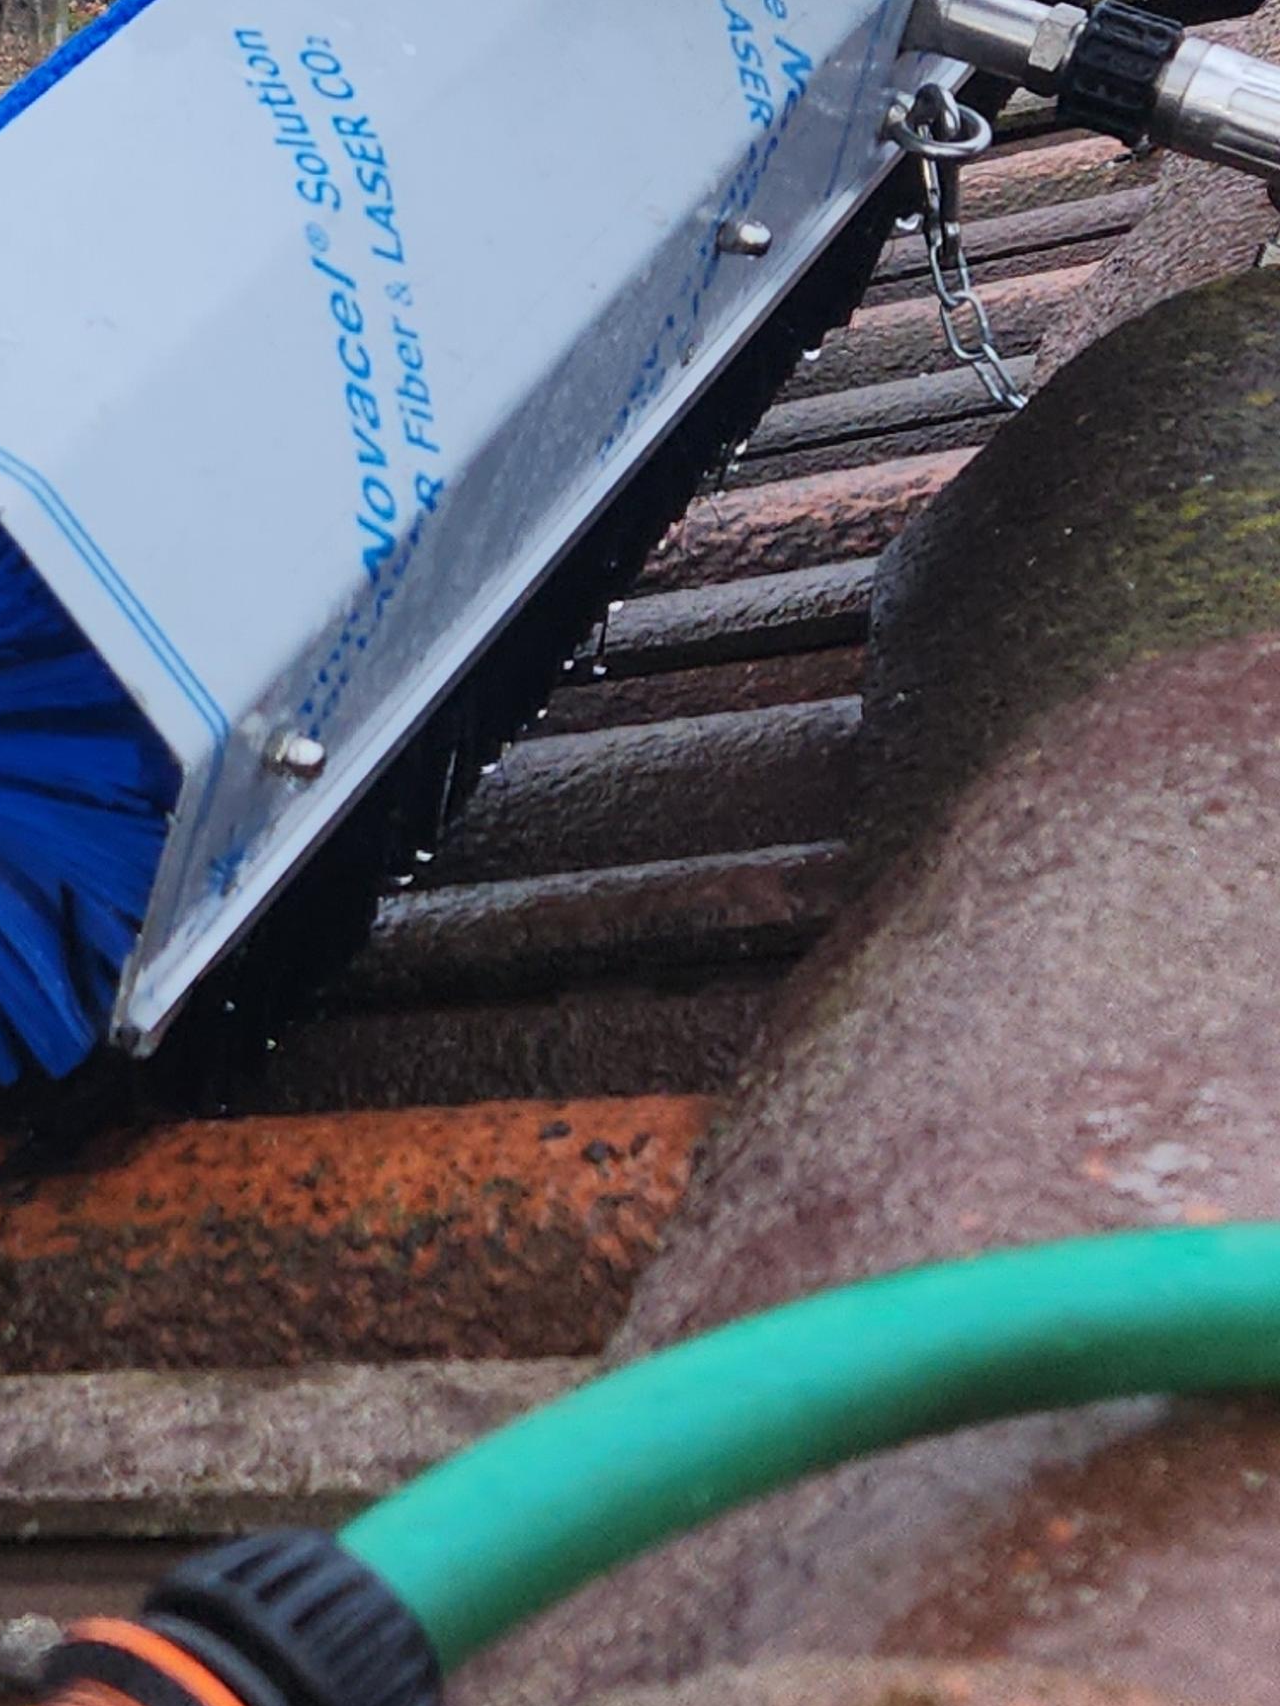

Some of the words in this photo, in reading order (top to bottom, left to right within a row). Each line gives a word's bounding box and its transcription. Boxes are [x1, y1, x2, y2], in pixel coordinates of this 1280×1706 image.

[233, 29, 342, 212] Solution
[332, 114, 406, 265] LASER
[392, 315, 441, 454] Fiber
